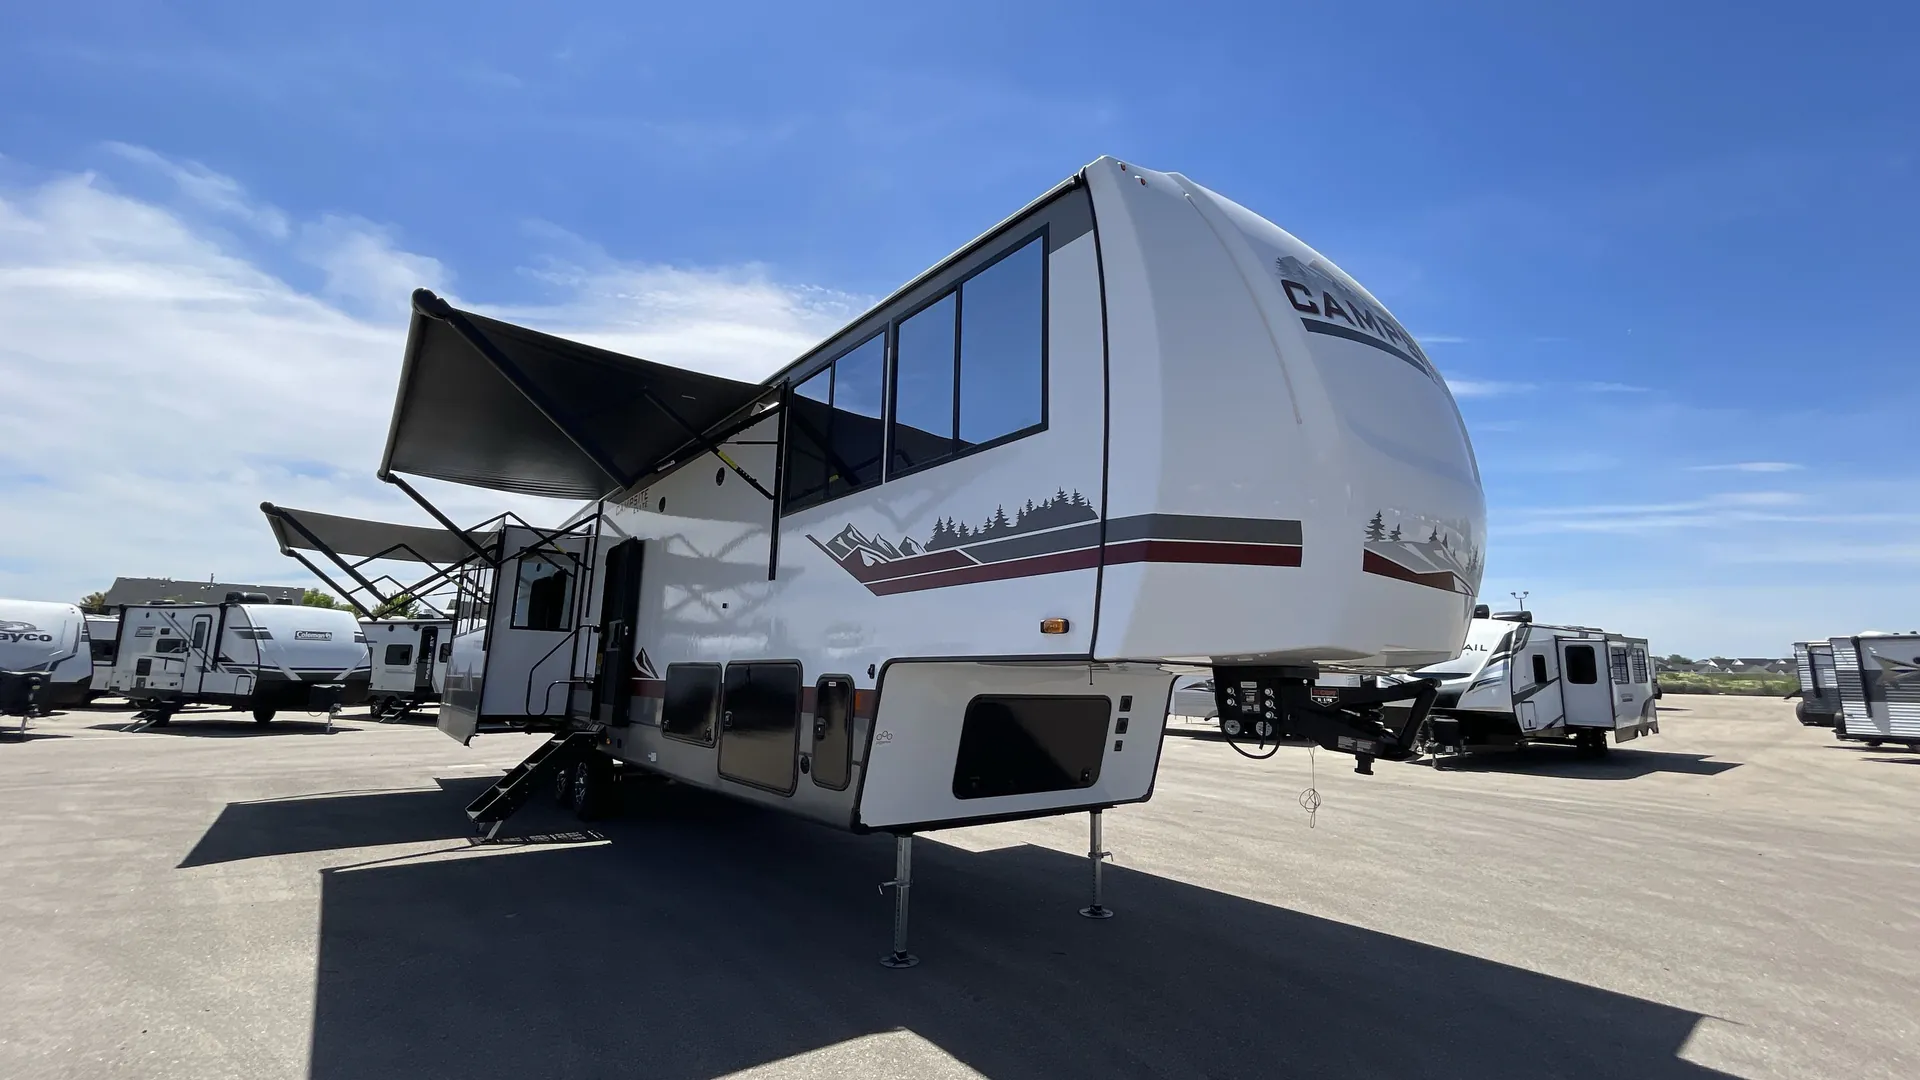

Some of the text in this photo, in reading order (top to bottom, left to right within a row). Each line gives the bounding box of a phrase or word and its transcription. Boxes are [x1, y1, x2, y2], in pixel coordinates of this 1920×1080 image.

[0, 632, 53, 643] ayco
[296, 631, 327, 639] Coleman
[1462, 643, 1488, 651] AIL
